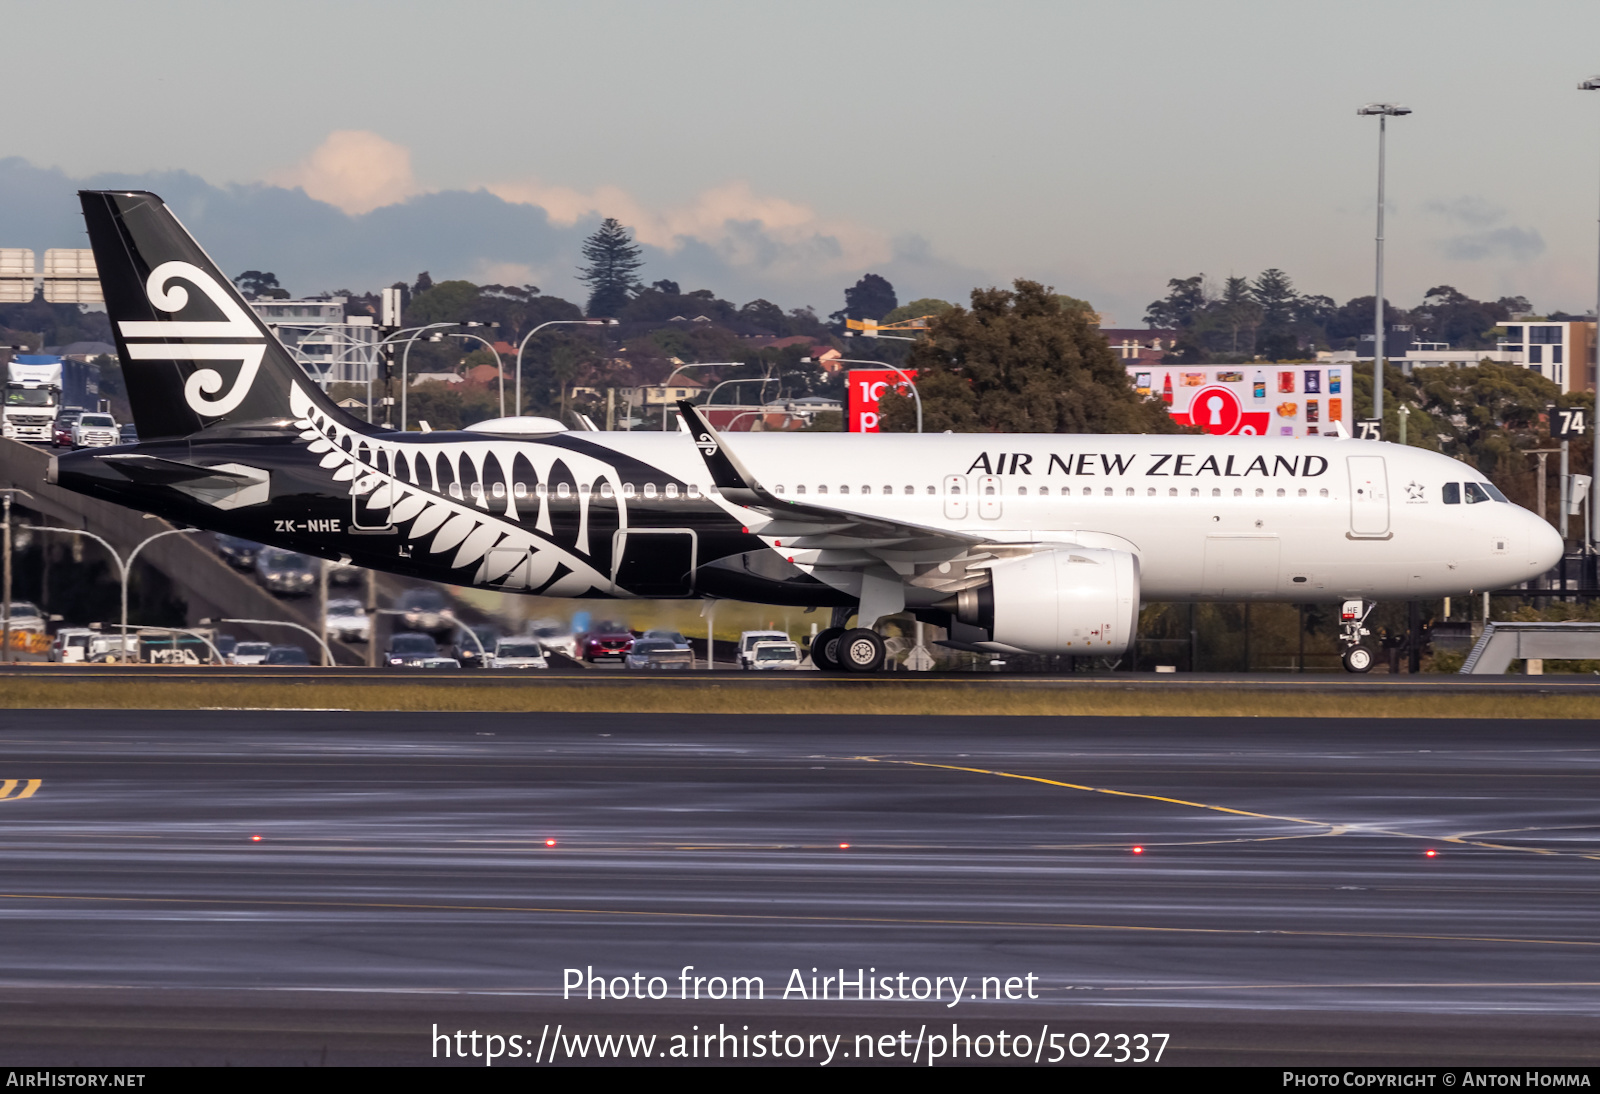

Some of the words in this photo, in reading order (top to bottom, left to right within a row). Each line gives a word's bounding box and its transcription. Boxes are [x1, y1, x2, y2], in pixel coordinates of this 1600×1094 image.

[1356, 422, 1381, 442] 75
[1558, 411, 1586, 435] 74
[966, 451, 1033, 475] AIR
[1047, 453, 1136, 476] NEW
[1145, 454, 1329, 477] ZEALAND
[274, 519, 342, 533] ZK-NHE
[1347, 606, 1359, 614] HE
